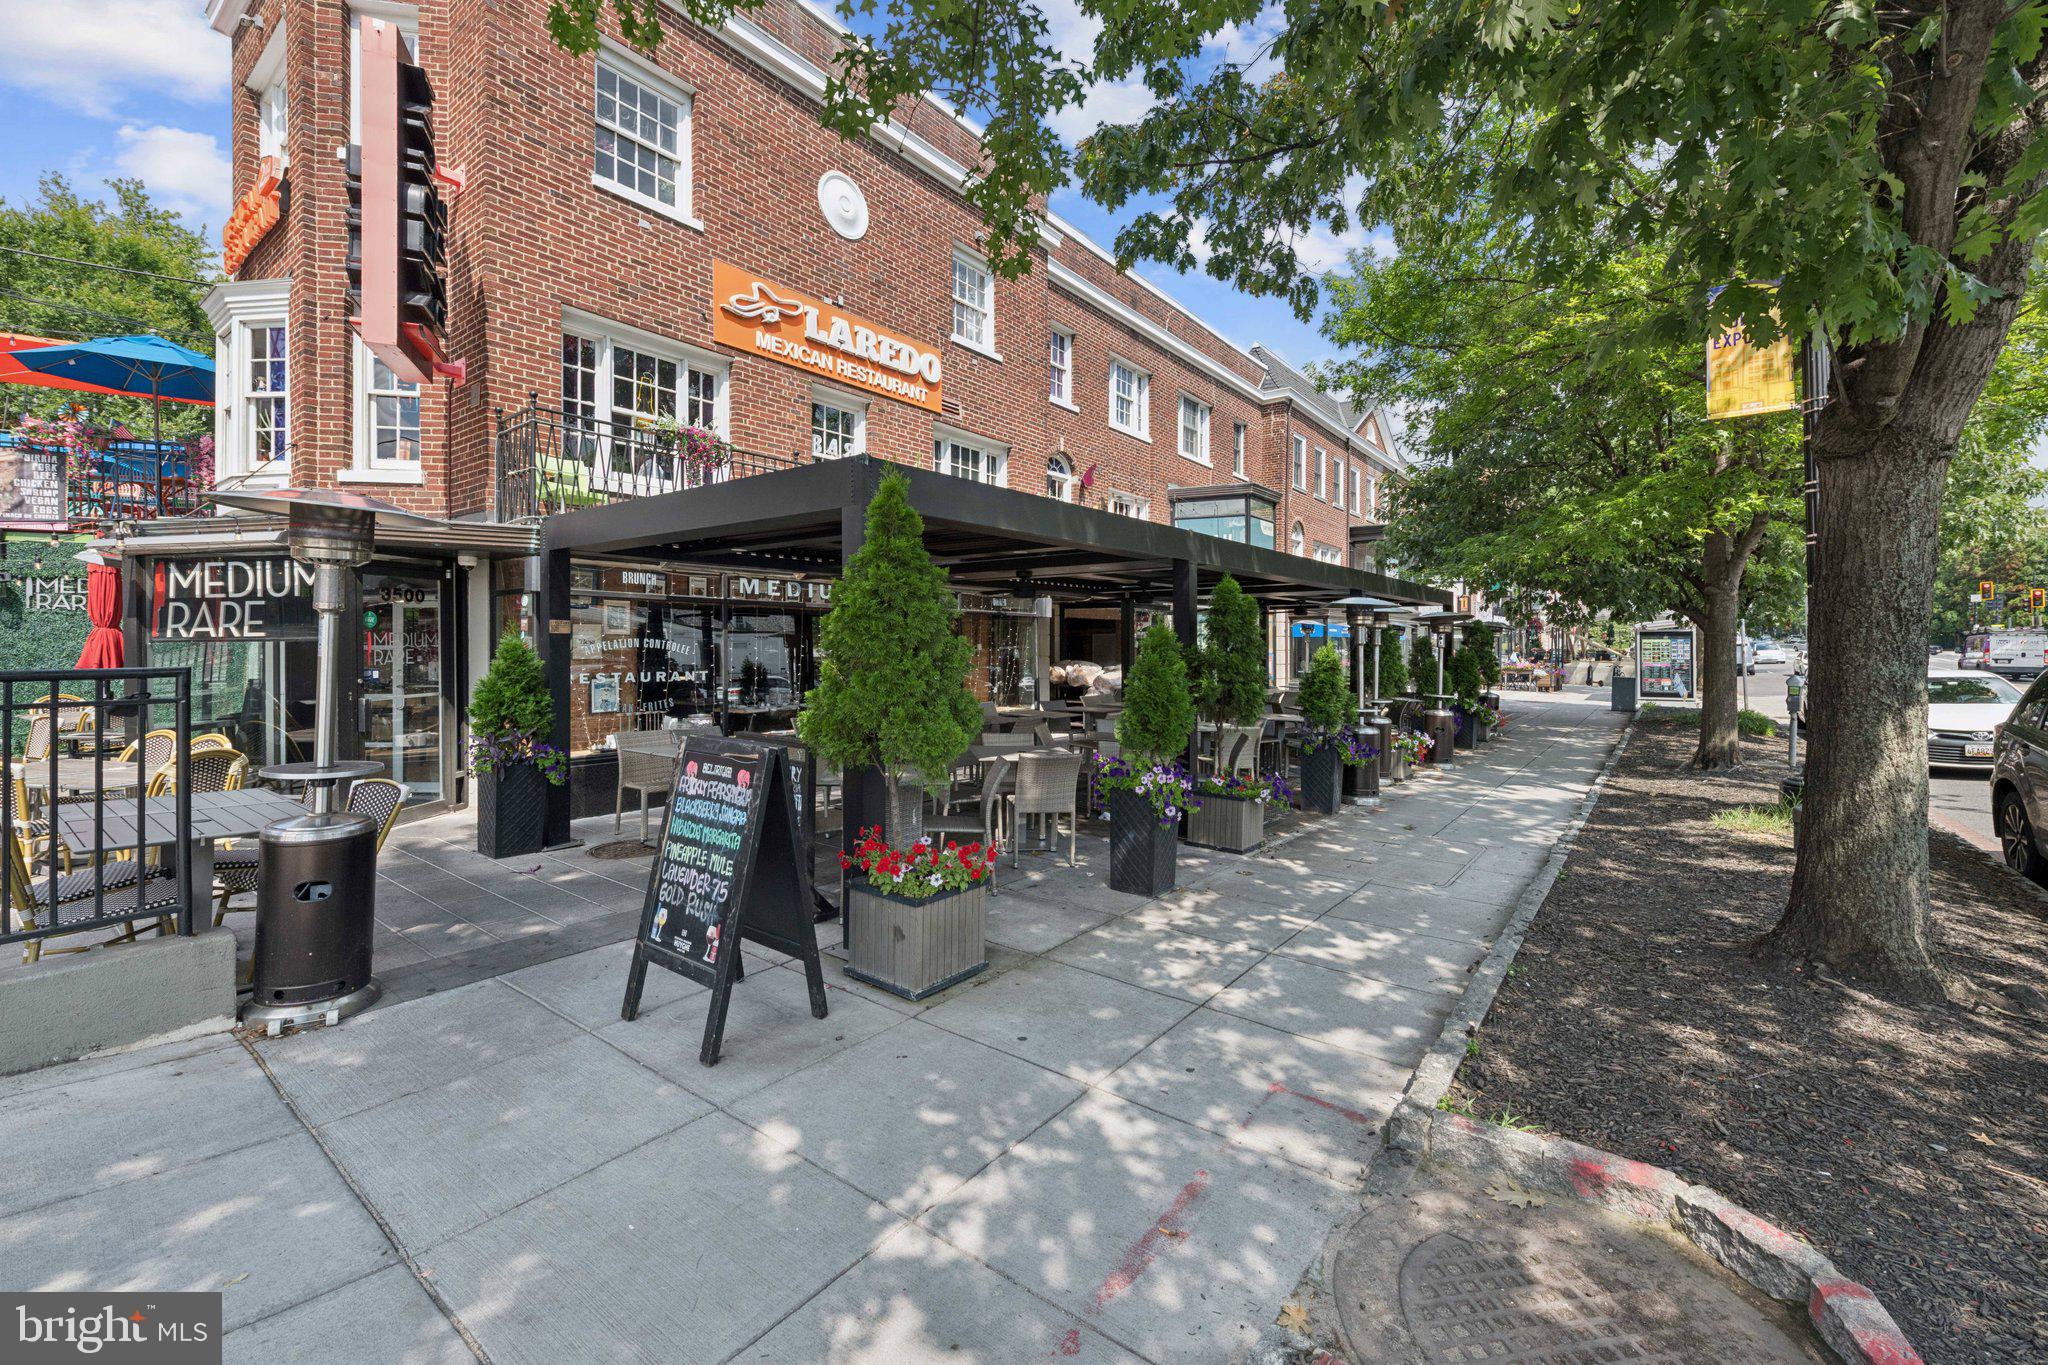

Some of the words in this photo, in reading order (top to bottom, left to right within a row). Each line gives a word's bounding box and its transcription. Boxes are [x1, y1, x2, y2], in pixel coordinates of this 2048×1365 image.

[803, 305, 942, 384] LAREDO
[756, 331, 834, 372] MEXICAN
[837, 358, 928, 402] RESTAURANT
[32, 463, 57, 471] PORK
[33, 471, 57, 480] BEEF
[14, 479, 58, 489] CHICKEN
[20, 488, 59, 497] SHRIMP
[24, 496, 59, 505] VEGAN
[33, 506, 59, 514] EGGS
[36, 578, 88, 594] MED
[622, 571, 657, 585] BRUNCH
[381, 586, 425, 602] 3500
[740, 577, 833, 599] MEDIU
[36, 594, 87, 611] RAR
[166, 600, 267, 637] RARE
[373, 632, 437, 648] MEDIUM
[643, 638, 691, 655] CONTROLEE
[570, 670, 708, 684] ESTAURANT
[643, 697, 675, 713] FRITES
[701, 826, 742, 850] MARGARITA
[664, 840, 708, 867] PINEAPPLE
[708, 853, 734, 876] MULE
[659, 881, 685, 906] GOLD
[711, 878, 729, 903] 75
